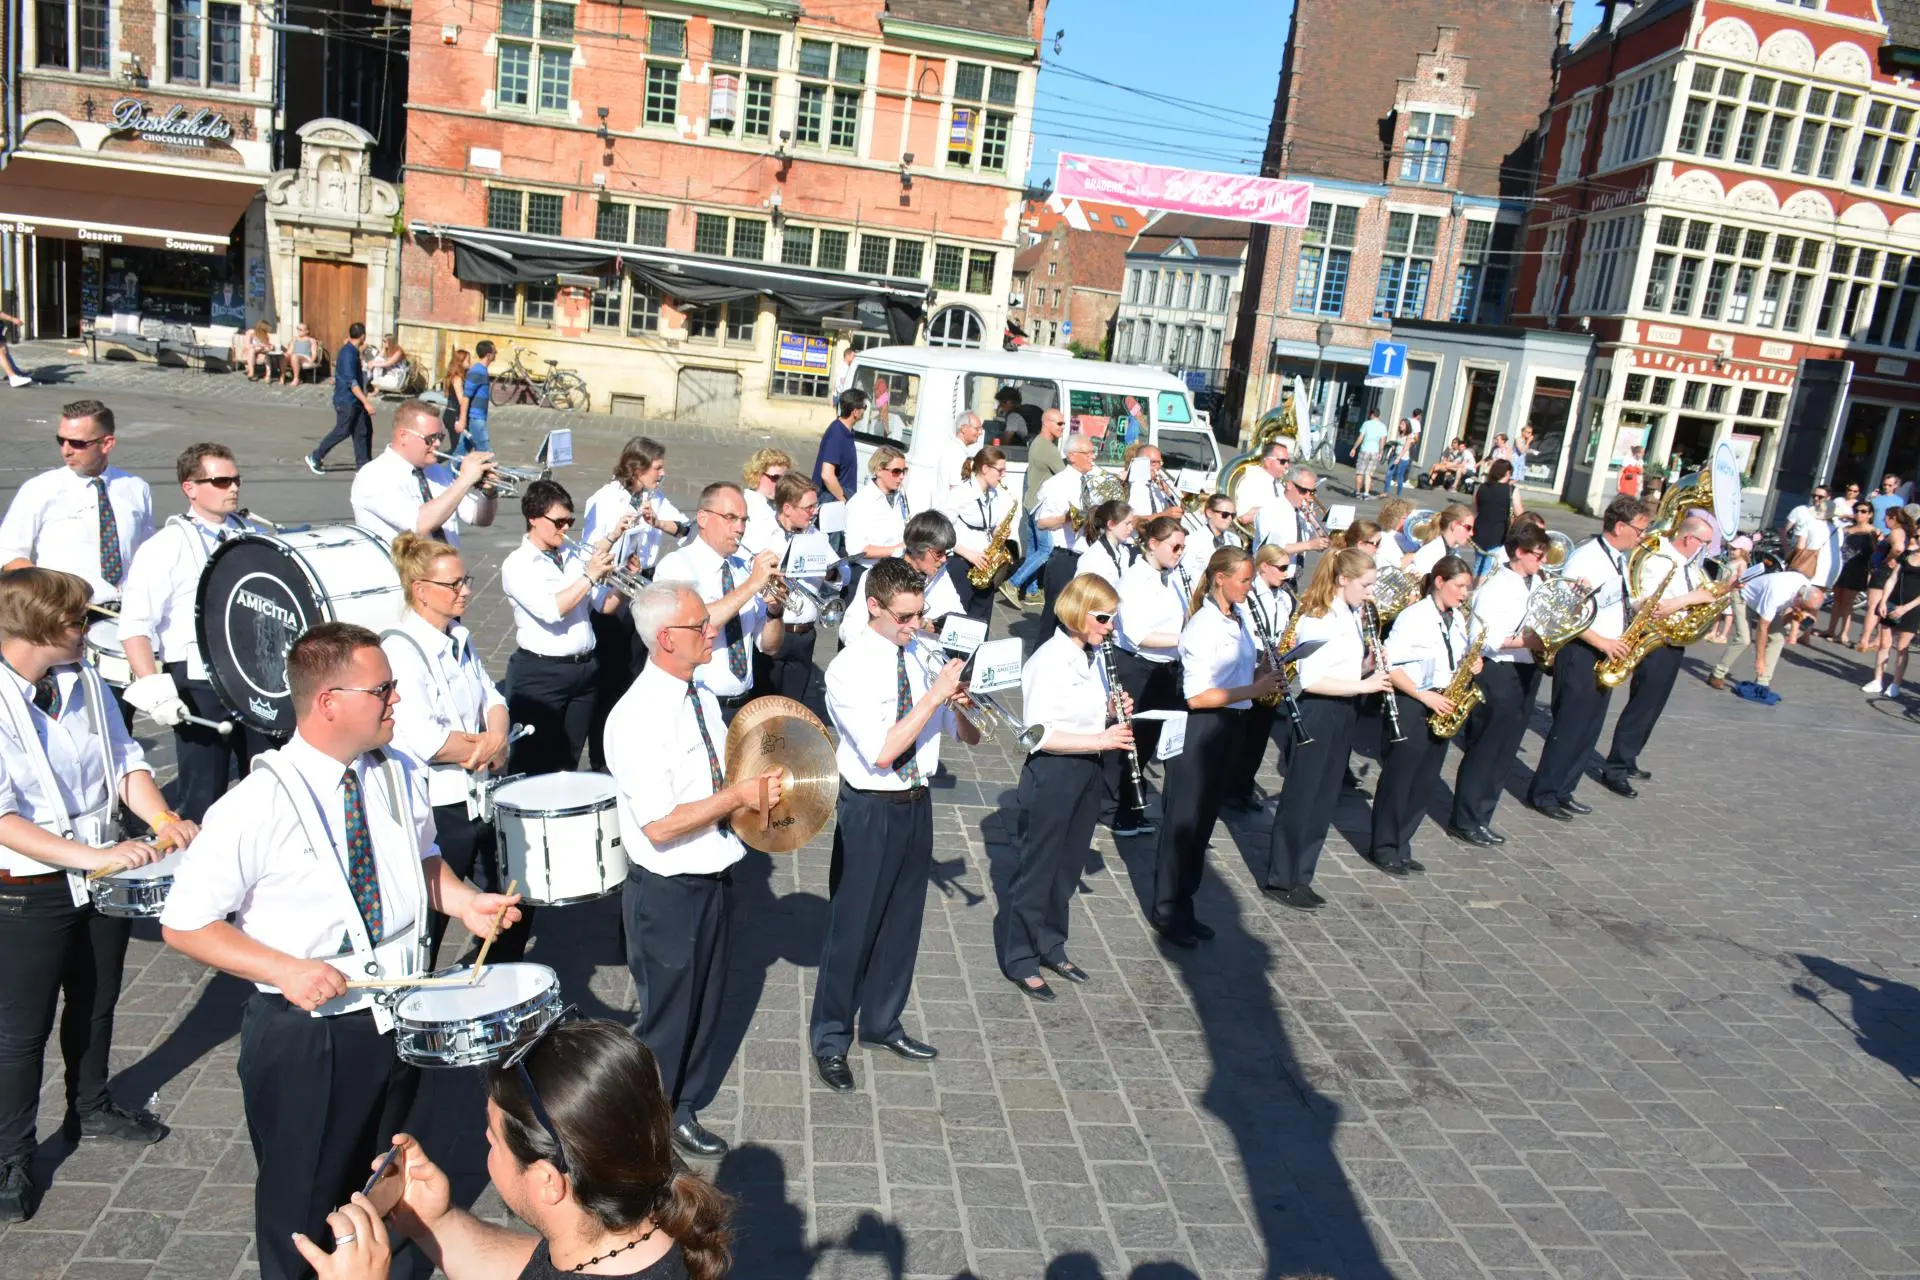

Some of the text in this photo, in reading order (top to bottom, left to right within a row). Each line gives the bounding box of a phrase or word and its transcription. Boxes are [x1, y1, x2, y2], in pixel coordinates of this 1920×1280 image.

[142, 133, 204, 147] CHOCOLATIER
[17, 223, 36, 234] Bar
[78, 229, 123, 243] Desserts
[166, 238, 215, 252] Souvenirs
[236, 592, 298, 627] AMICITIA
